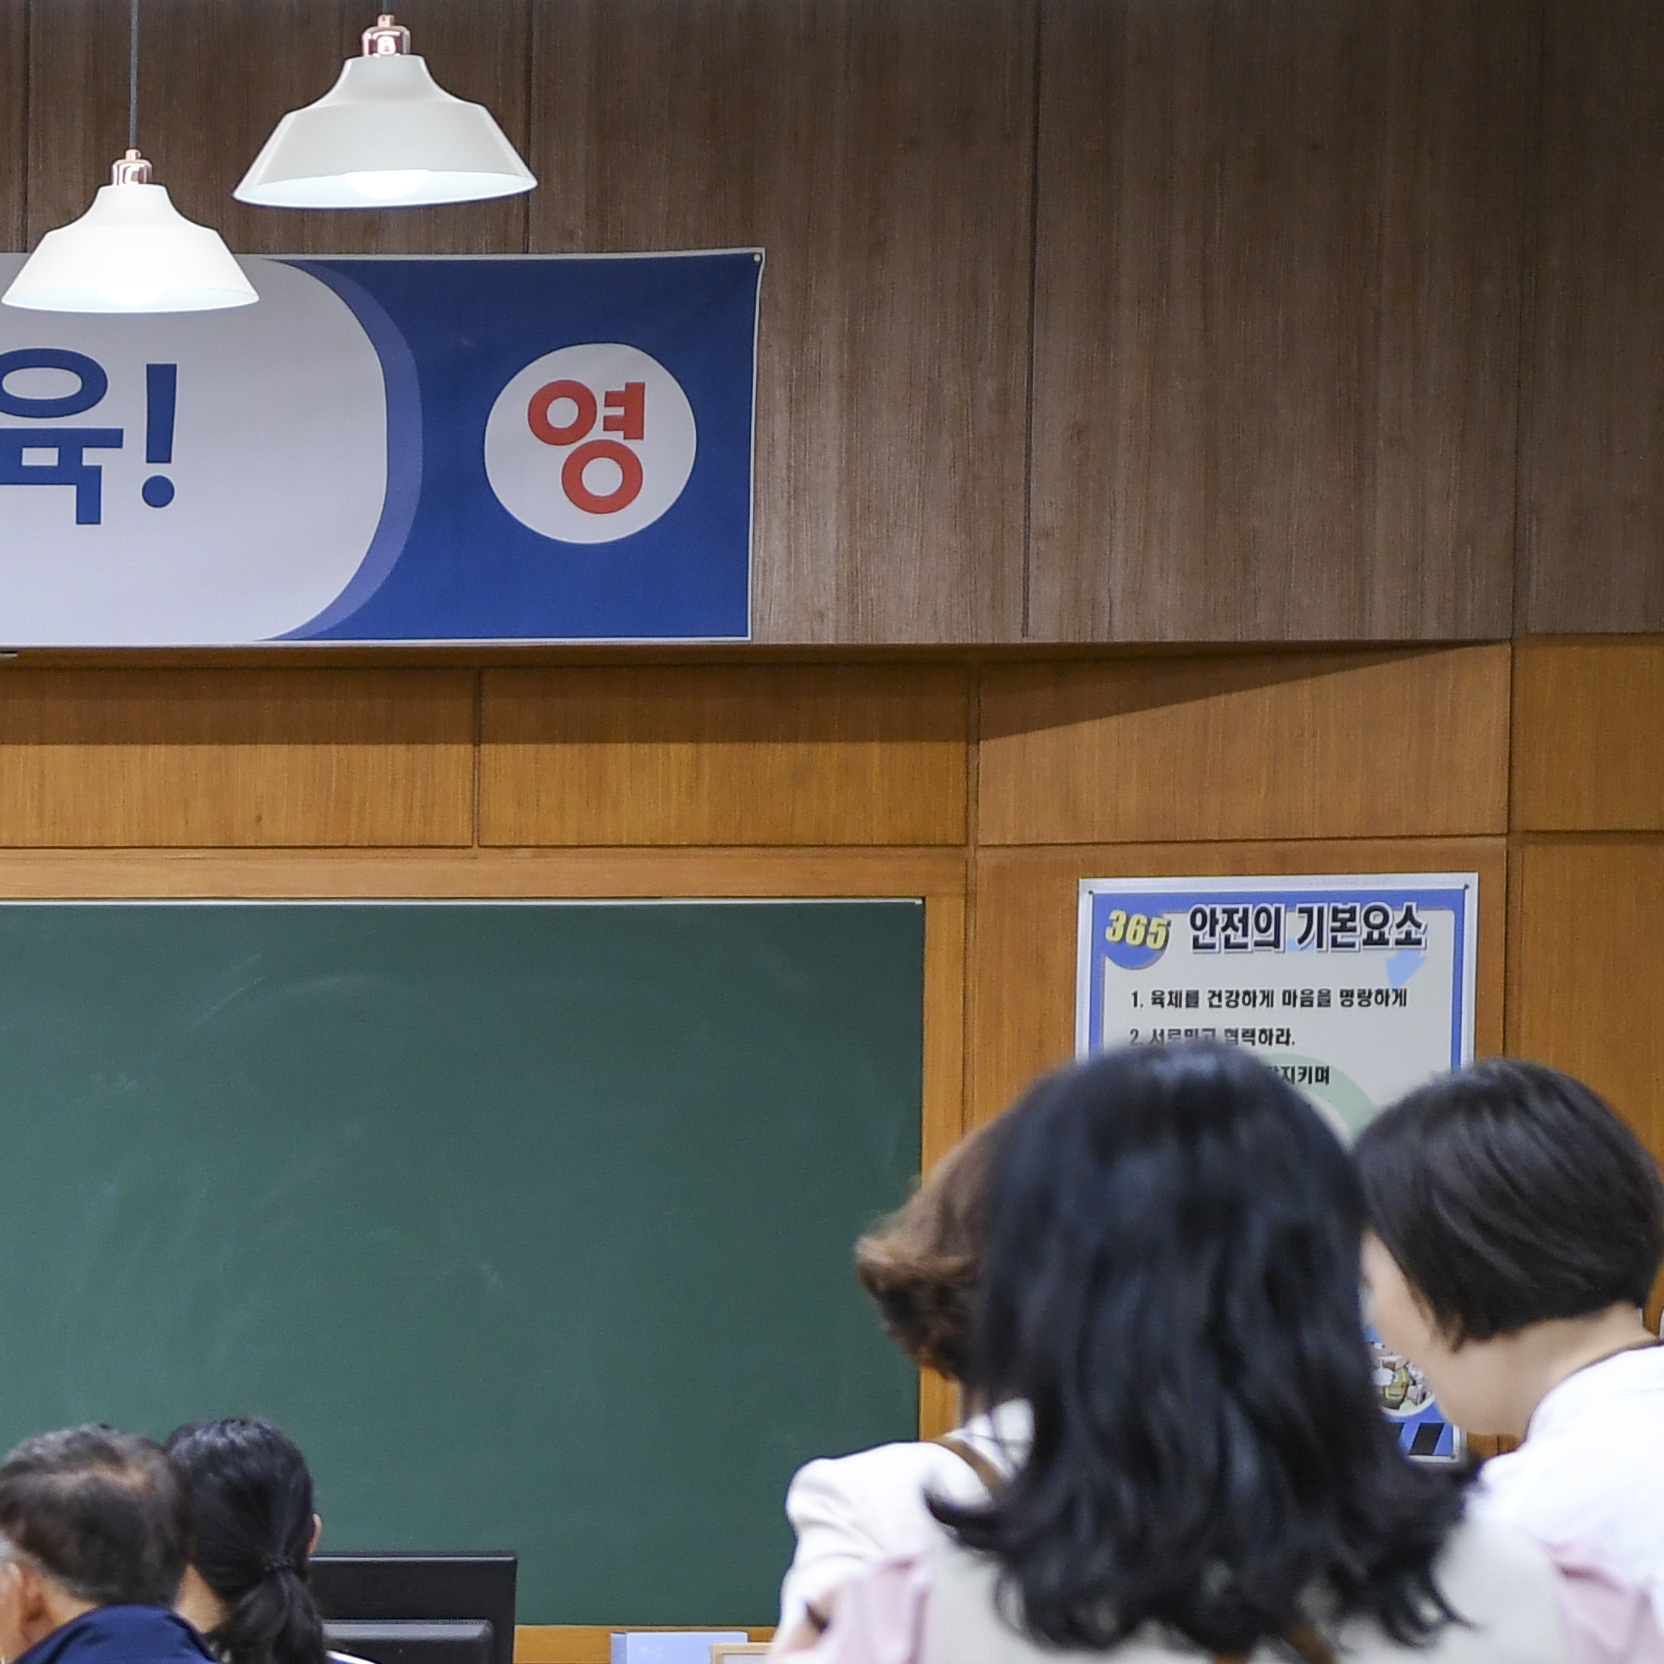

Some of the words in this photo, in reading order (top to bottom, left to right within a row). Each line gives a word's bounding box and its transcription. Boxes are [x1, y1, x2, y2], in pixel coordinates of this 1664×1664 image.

[529, 380, 645, 515] 영
[1105, 909, 1170, 950] 365
[1190, 907, 1281, 950] 안전의
[1297, 905, 1422, 950] 기본요소
[1131, 990, 1144, 1009] 1.
[1207, 989, 1275, 1009] 건강하게
[1281, 988, 1332, 1009] 마음을
[1339, 987, 1408, 1009] 명랑하게
[1269, 1065, 1330, 1085] 지키며
